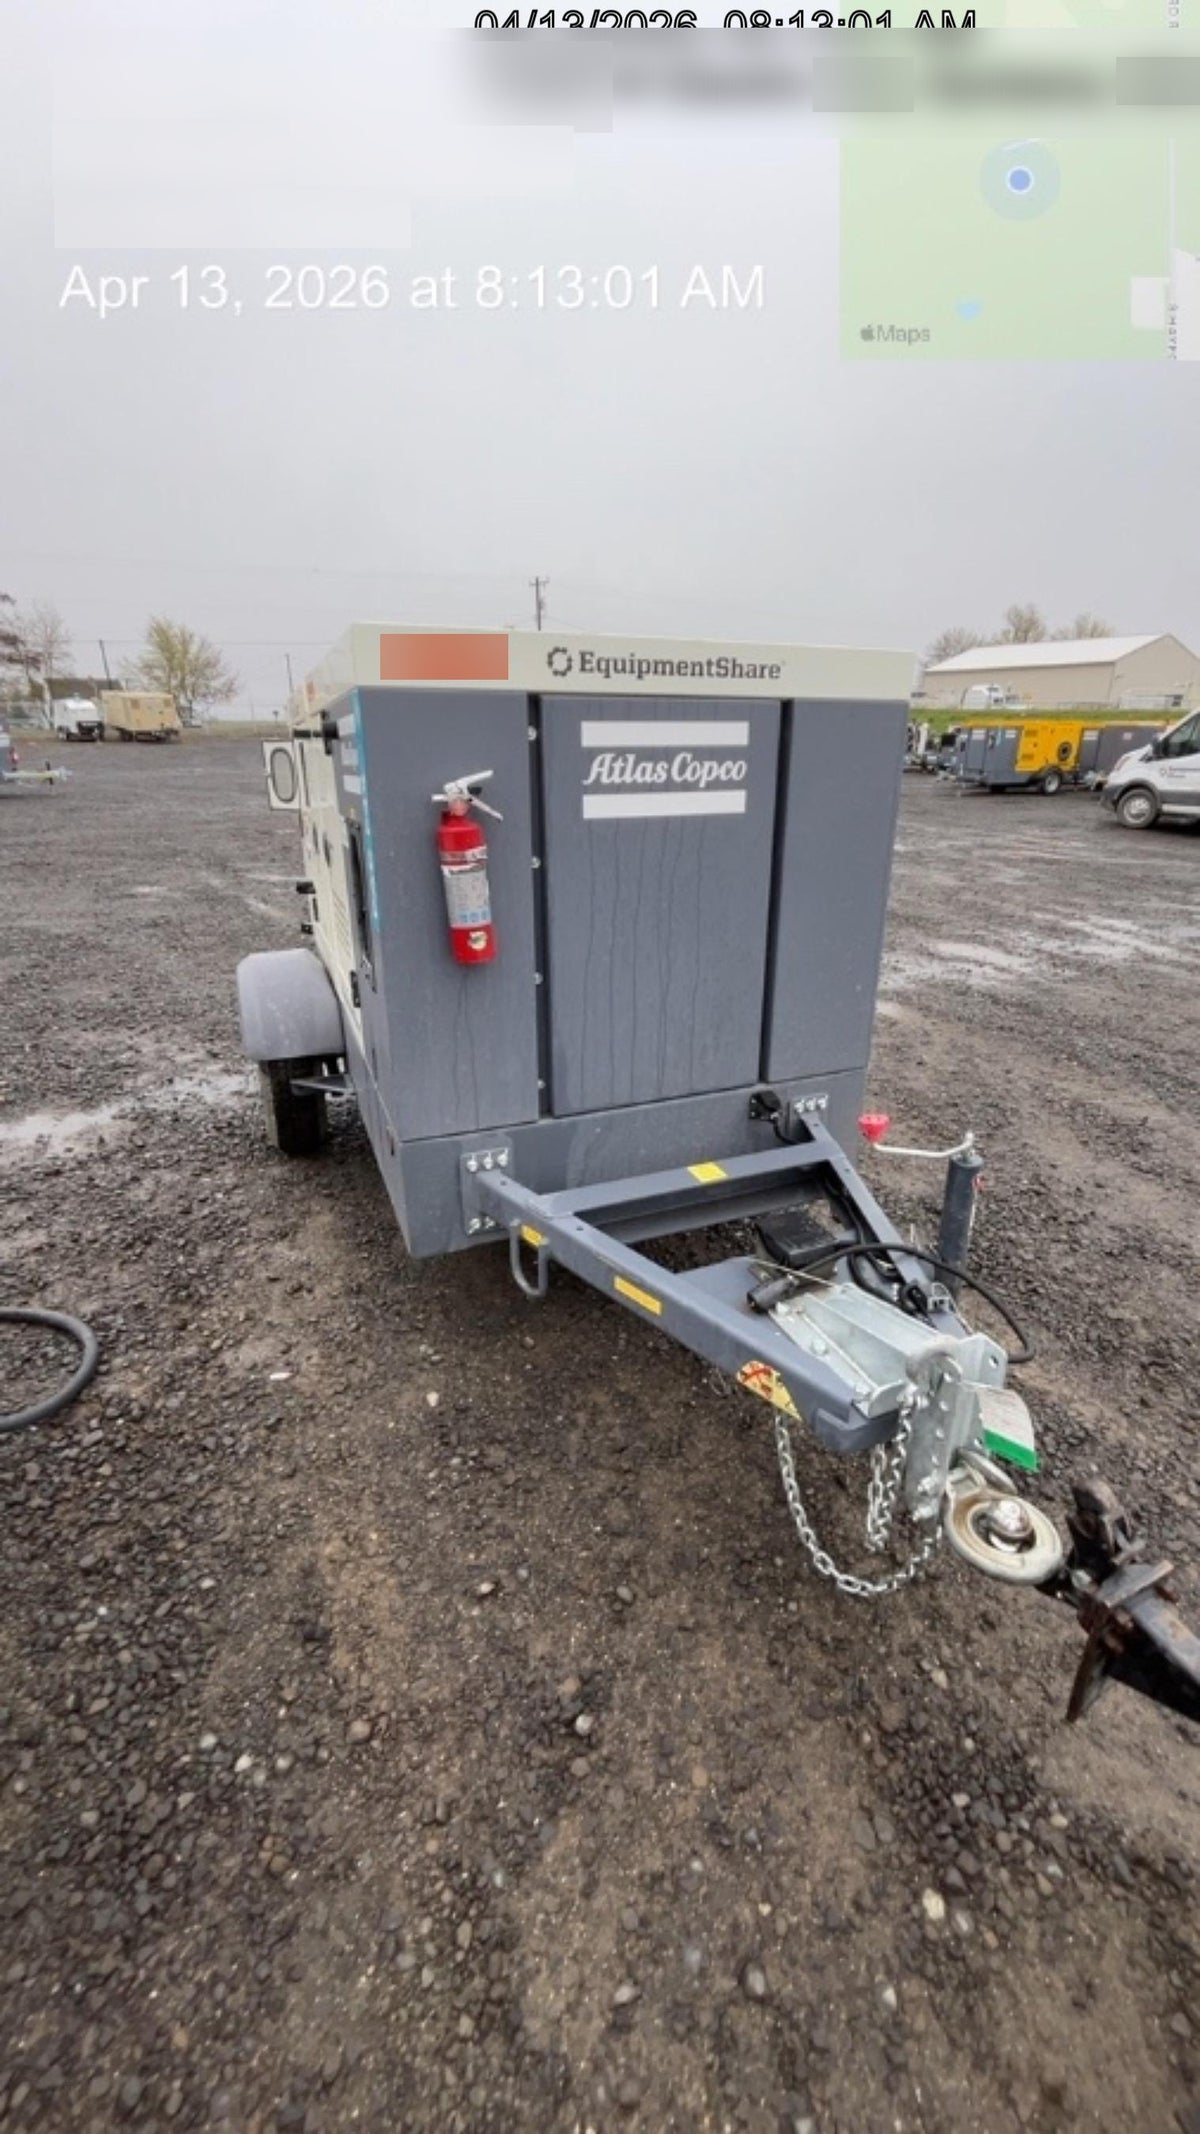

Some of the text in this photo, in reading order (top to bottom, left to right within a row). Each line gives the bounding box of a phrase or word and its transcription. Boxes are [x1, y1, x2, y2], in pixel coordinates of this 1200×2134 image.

[578, 650, 782, 681] EquipmentShare
[582, 751, 748, 788] Atlas Copco
